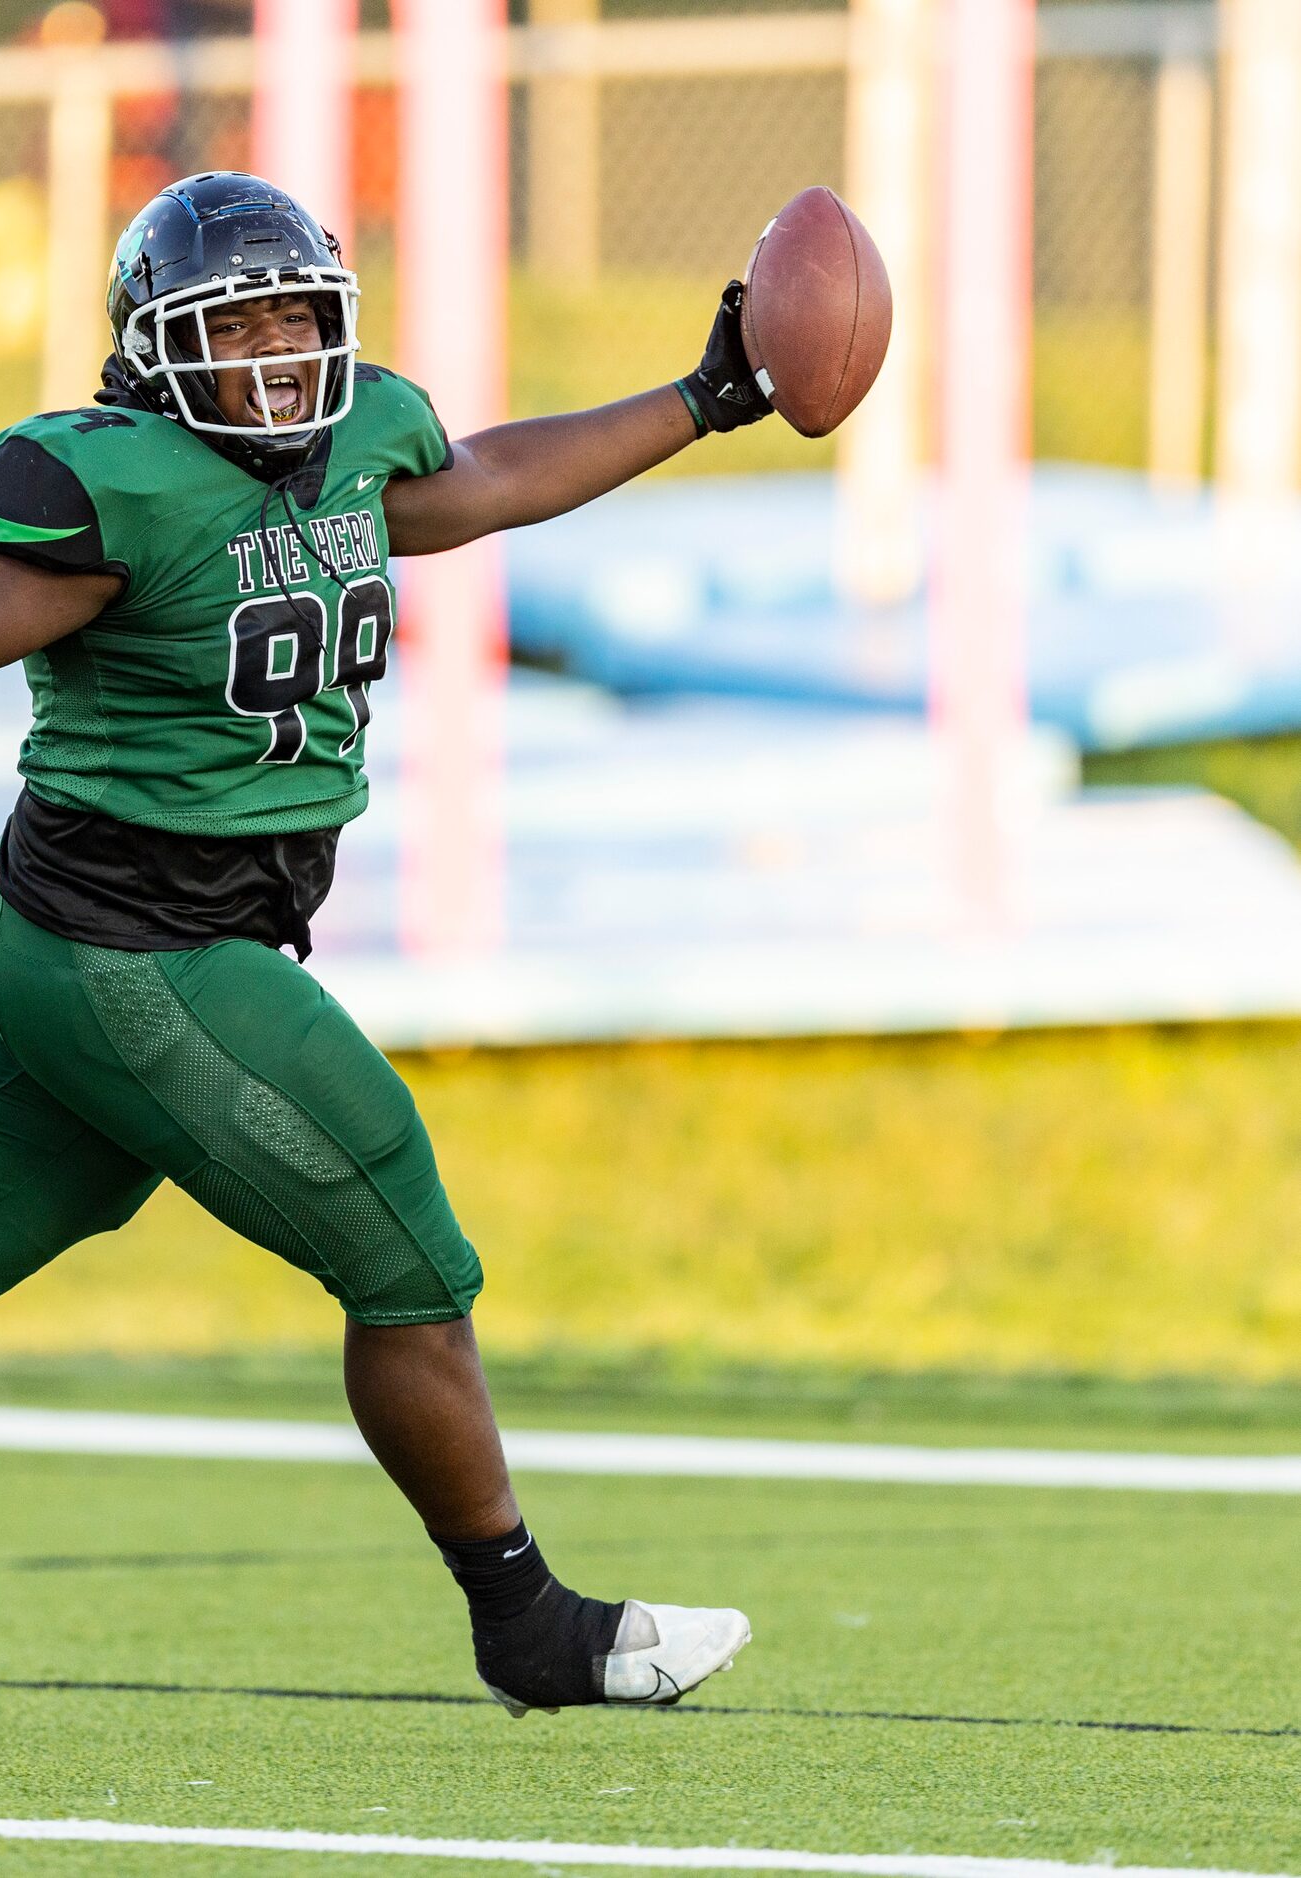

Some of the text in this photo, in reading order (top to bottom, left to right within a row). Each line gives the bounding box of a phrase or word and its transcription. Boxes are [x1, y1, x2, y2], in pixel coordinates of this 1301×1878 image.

[227, 510, 380, 593] THE HERD
[225, 575, 394, 764] 99
